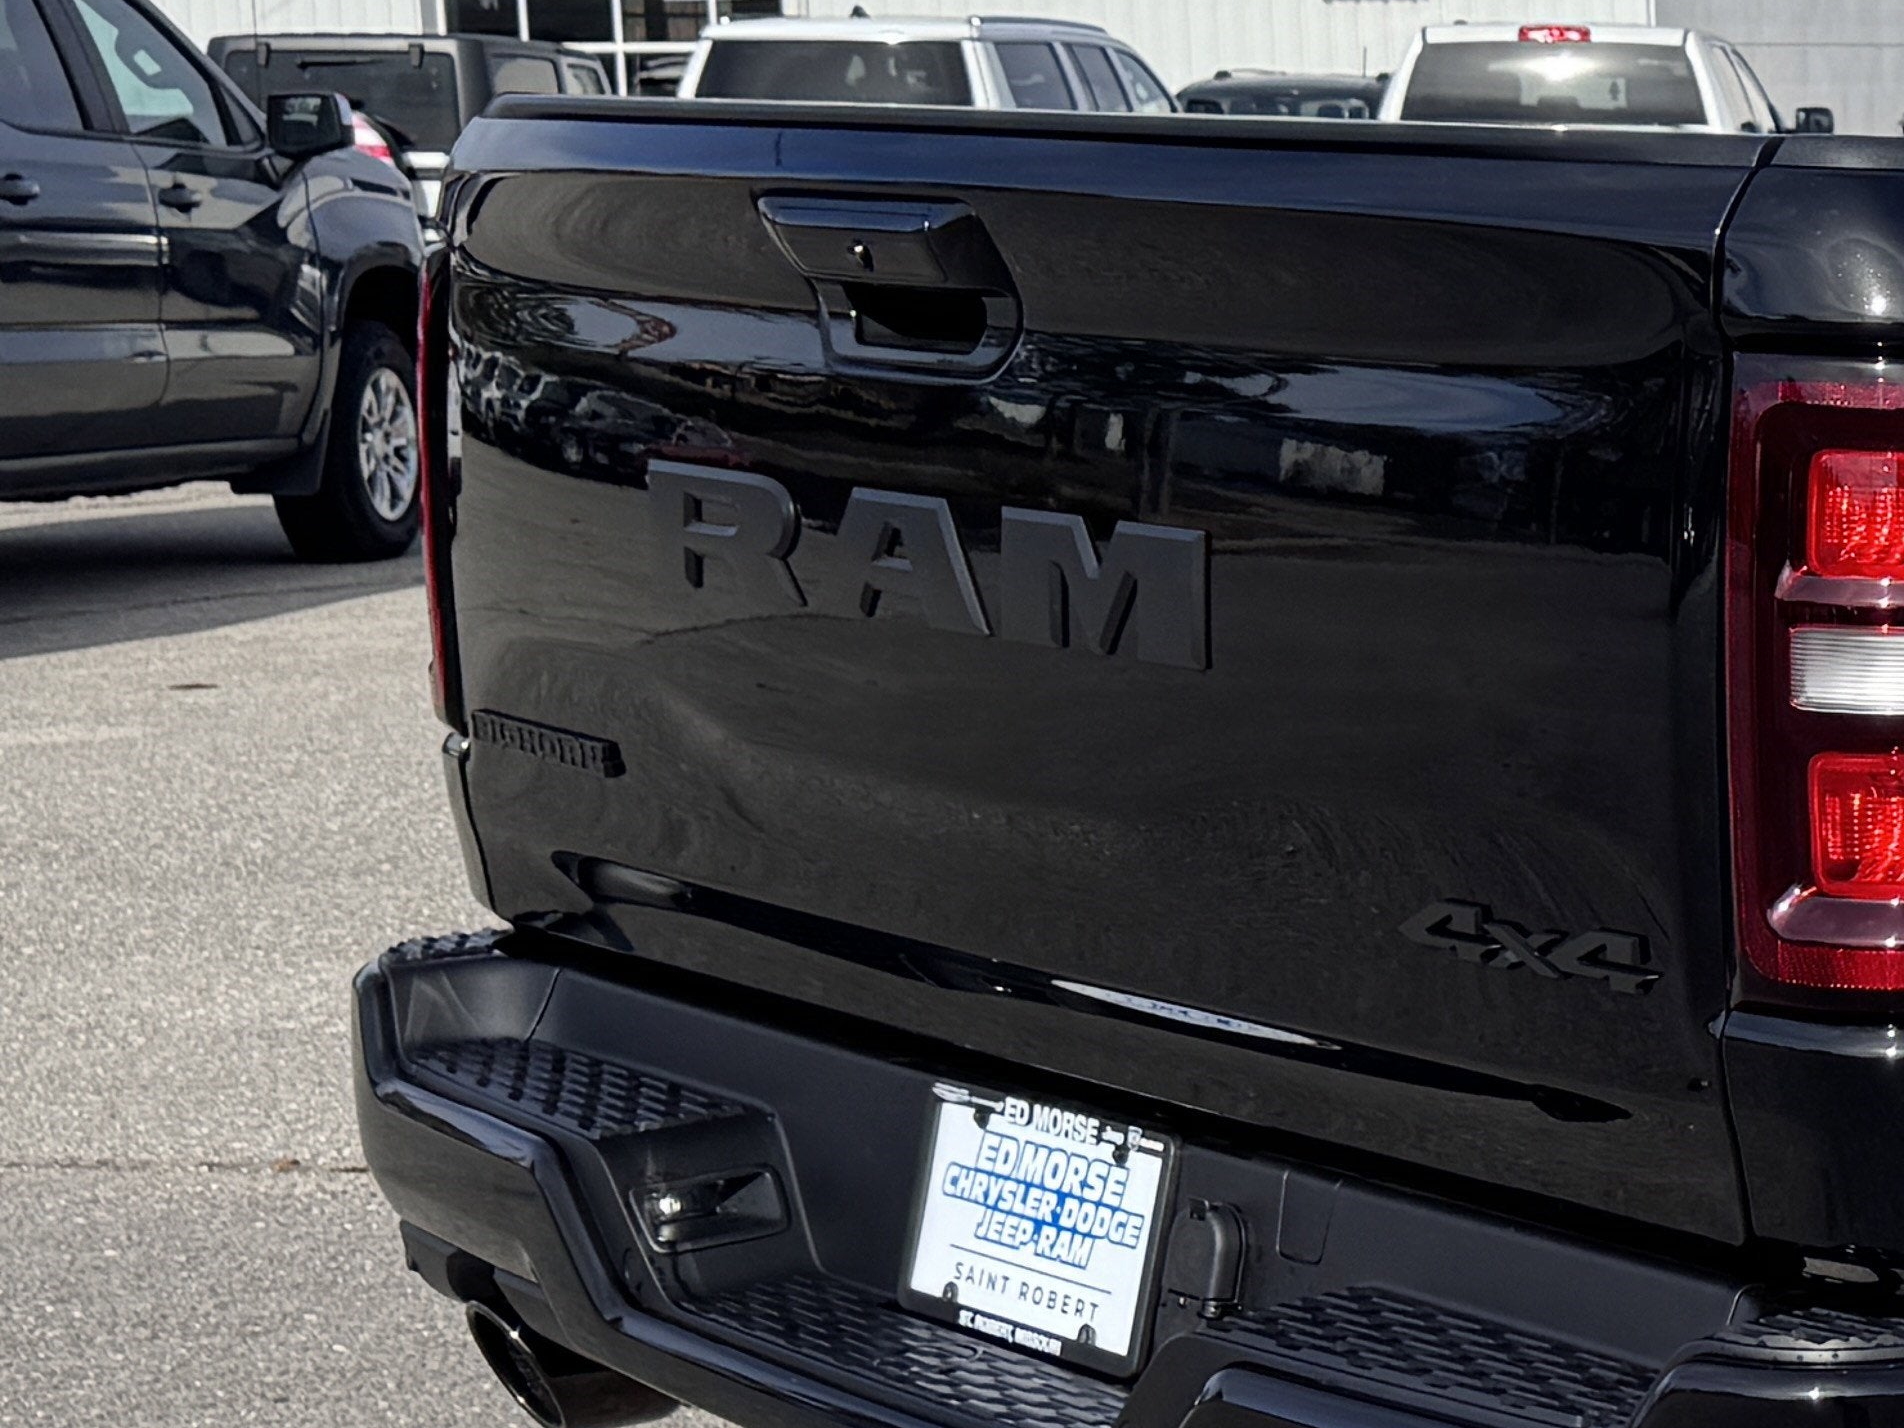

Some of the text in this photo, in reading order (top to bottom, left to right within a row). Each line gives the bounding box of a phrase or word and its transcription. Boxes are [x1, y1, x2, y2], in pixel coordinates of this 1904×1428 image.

[646, 458, 1213, 673] RAM
[1399, 897, 1664, 995] 4x4
[1003, 1096, 1030, 1127] ED
[1032, 1103, 1101, 1146] MORSE
[977, 1130, 1130, 1209] ED MORSE
[953, 1261, 1100, 1322] SAINT ROBERT
